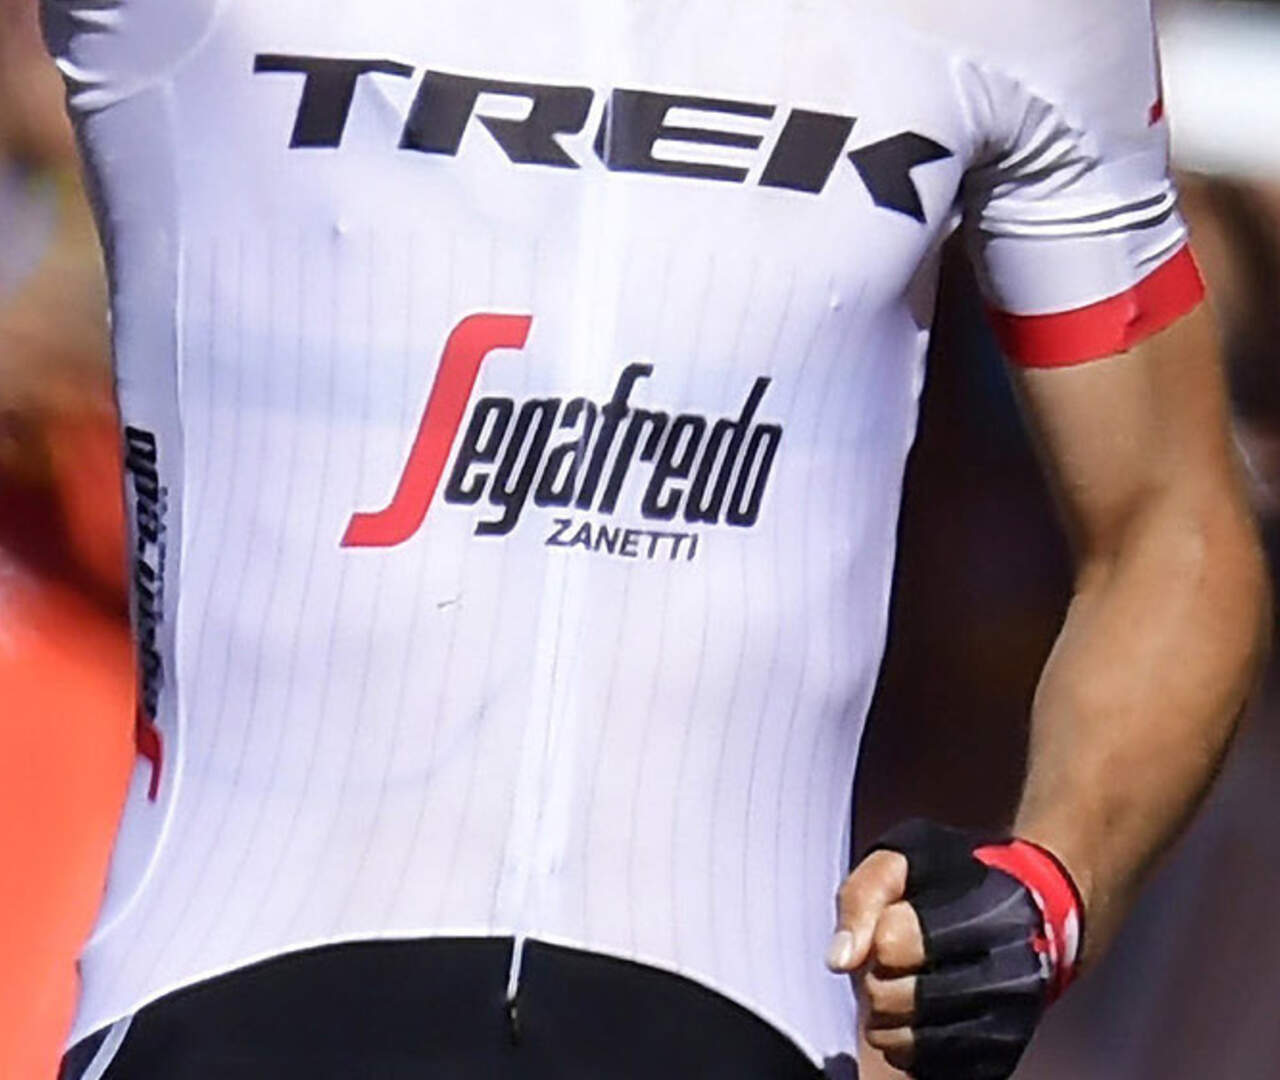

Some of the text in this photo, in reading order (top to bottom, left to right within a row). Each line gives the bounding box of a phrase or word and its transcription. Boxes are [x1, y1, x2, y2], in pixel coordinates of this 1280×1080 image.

[253, 53, 954, 224] TREK
[339, 311, 783, 548] Segafredo
[545, 518, 698, 562] ZANETTI
